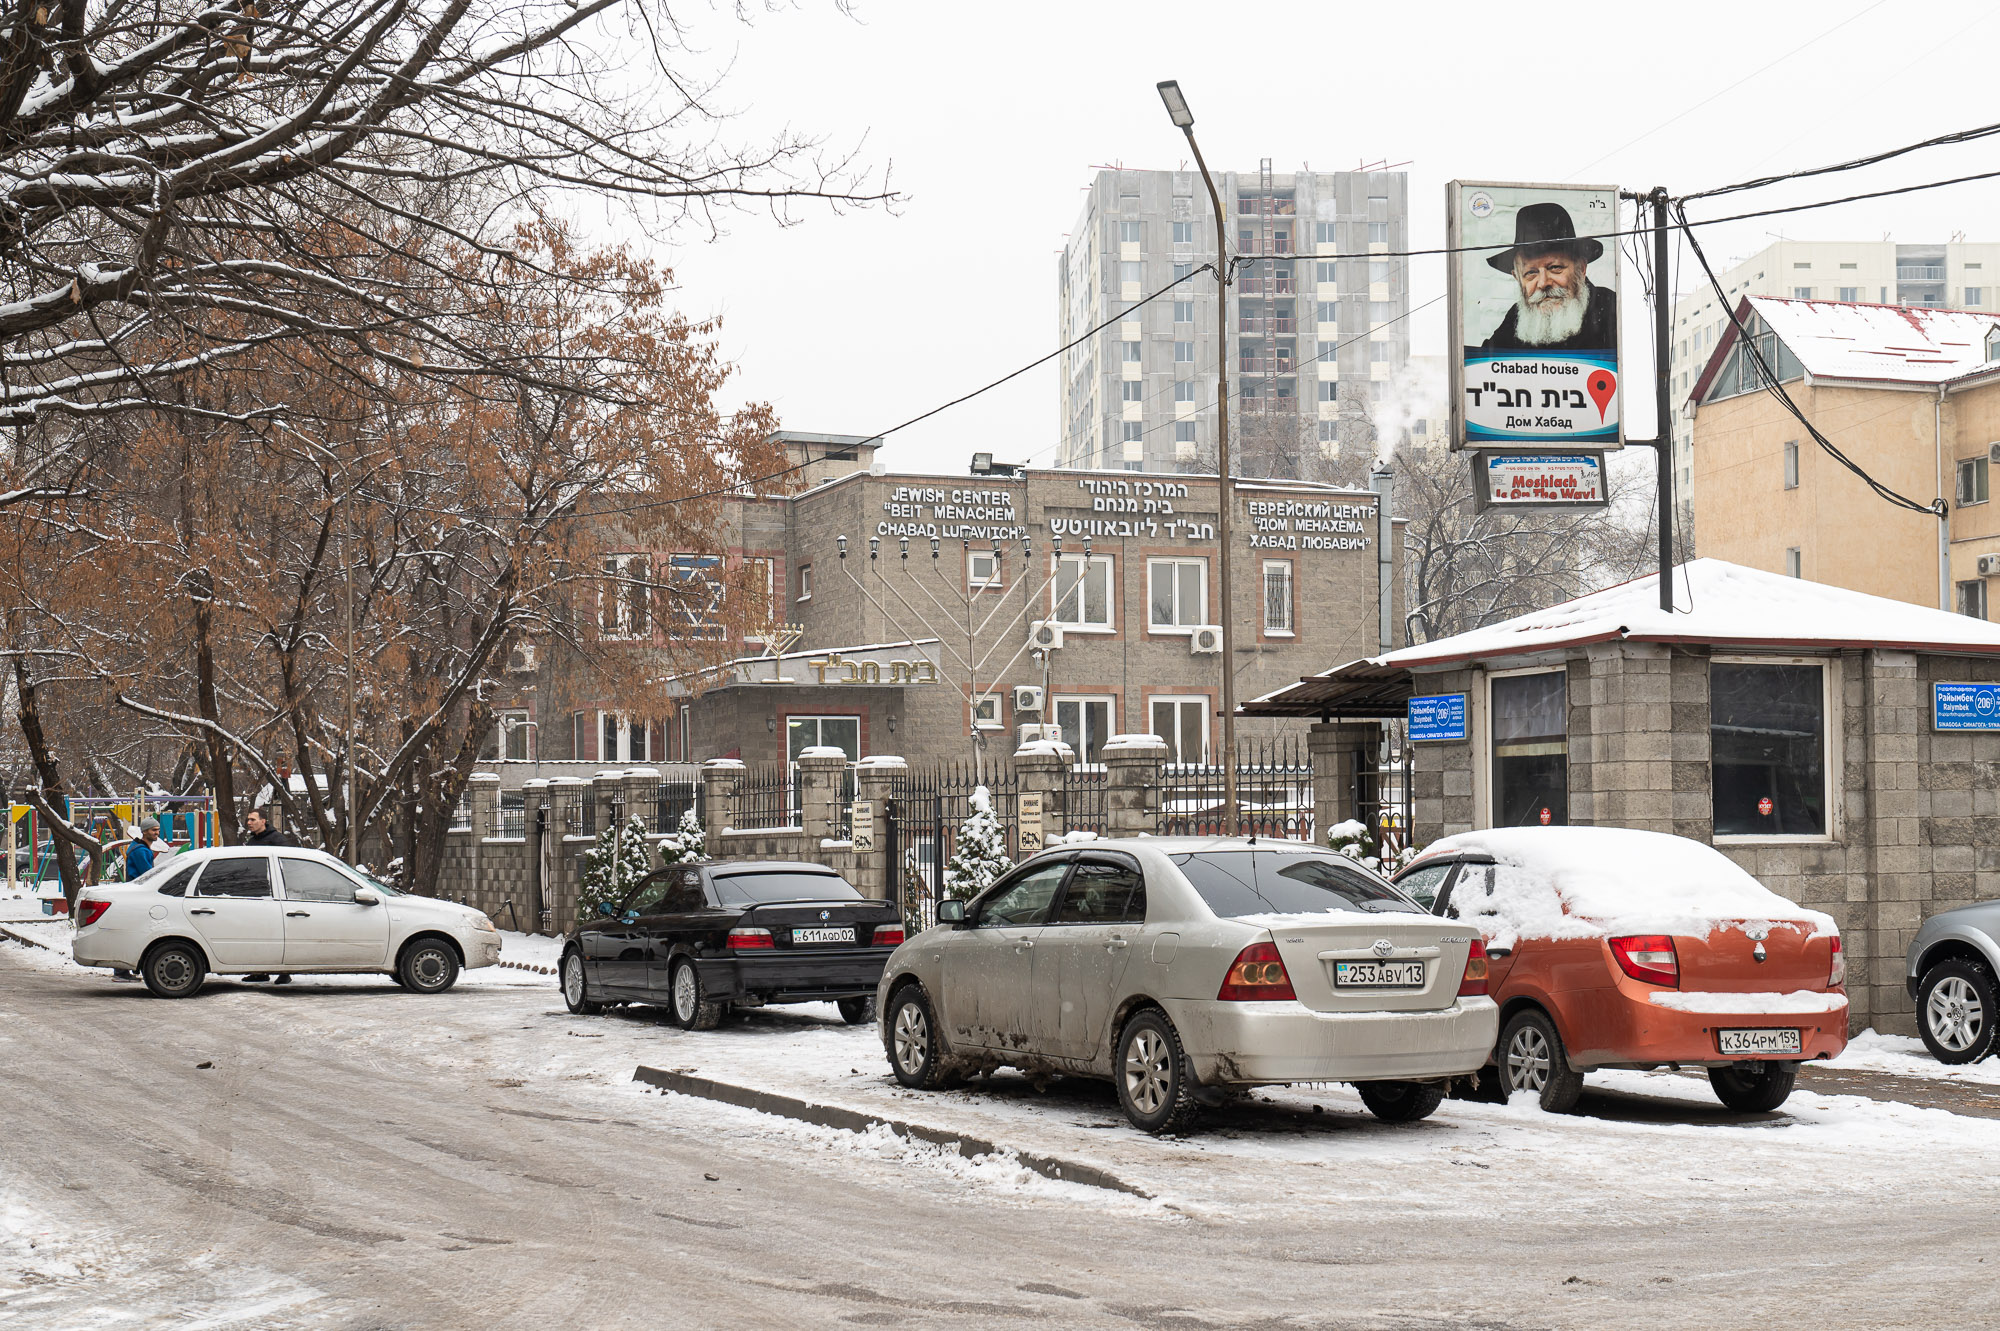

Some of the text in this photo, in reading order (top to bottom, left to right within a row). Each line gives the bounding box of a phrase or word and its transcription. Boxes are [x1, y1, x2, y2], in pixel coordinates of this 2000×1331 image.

[1491, 361, 1579, 375] Chabad house
[1466, 381, 1587, 409] בית חב"ד
[1505, 415, 1573, 429] Дом Хабад
[1079, 479, 1189, 498] המרכז היהודי
[1512, 474, 1577, 488] Moshiach
[891, 487, 1012, 506] JEWISH CENTER
[1533, 488, 1558, 500] The
[934, 505, 1016, 521] MENACHEM
[1093, 497, 1174, 514] בית מנחם
[1249, 500, 1377, 520] ЕВРЕЙСКИЙ ЦЕНТР
[877, 521, 937, 537] CHABAD
[1050, 516, 1214, 540] חב"ד ליובאוויטש
[1295, 518, 1365, 534] МЕНАХЕМА
[1249, 534, 1297, 550] ХАБАД
[808, 652, 938, 684] בית חב"ד
[1938, 693, 1974, 702] Райымбек
[1410, 706, 1435, 715] Райымбек
[842, 930, 854, 940] 02
[1338, 975, 1348, 983] KZ
[1405, 965, 1422, 983] 13
